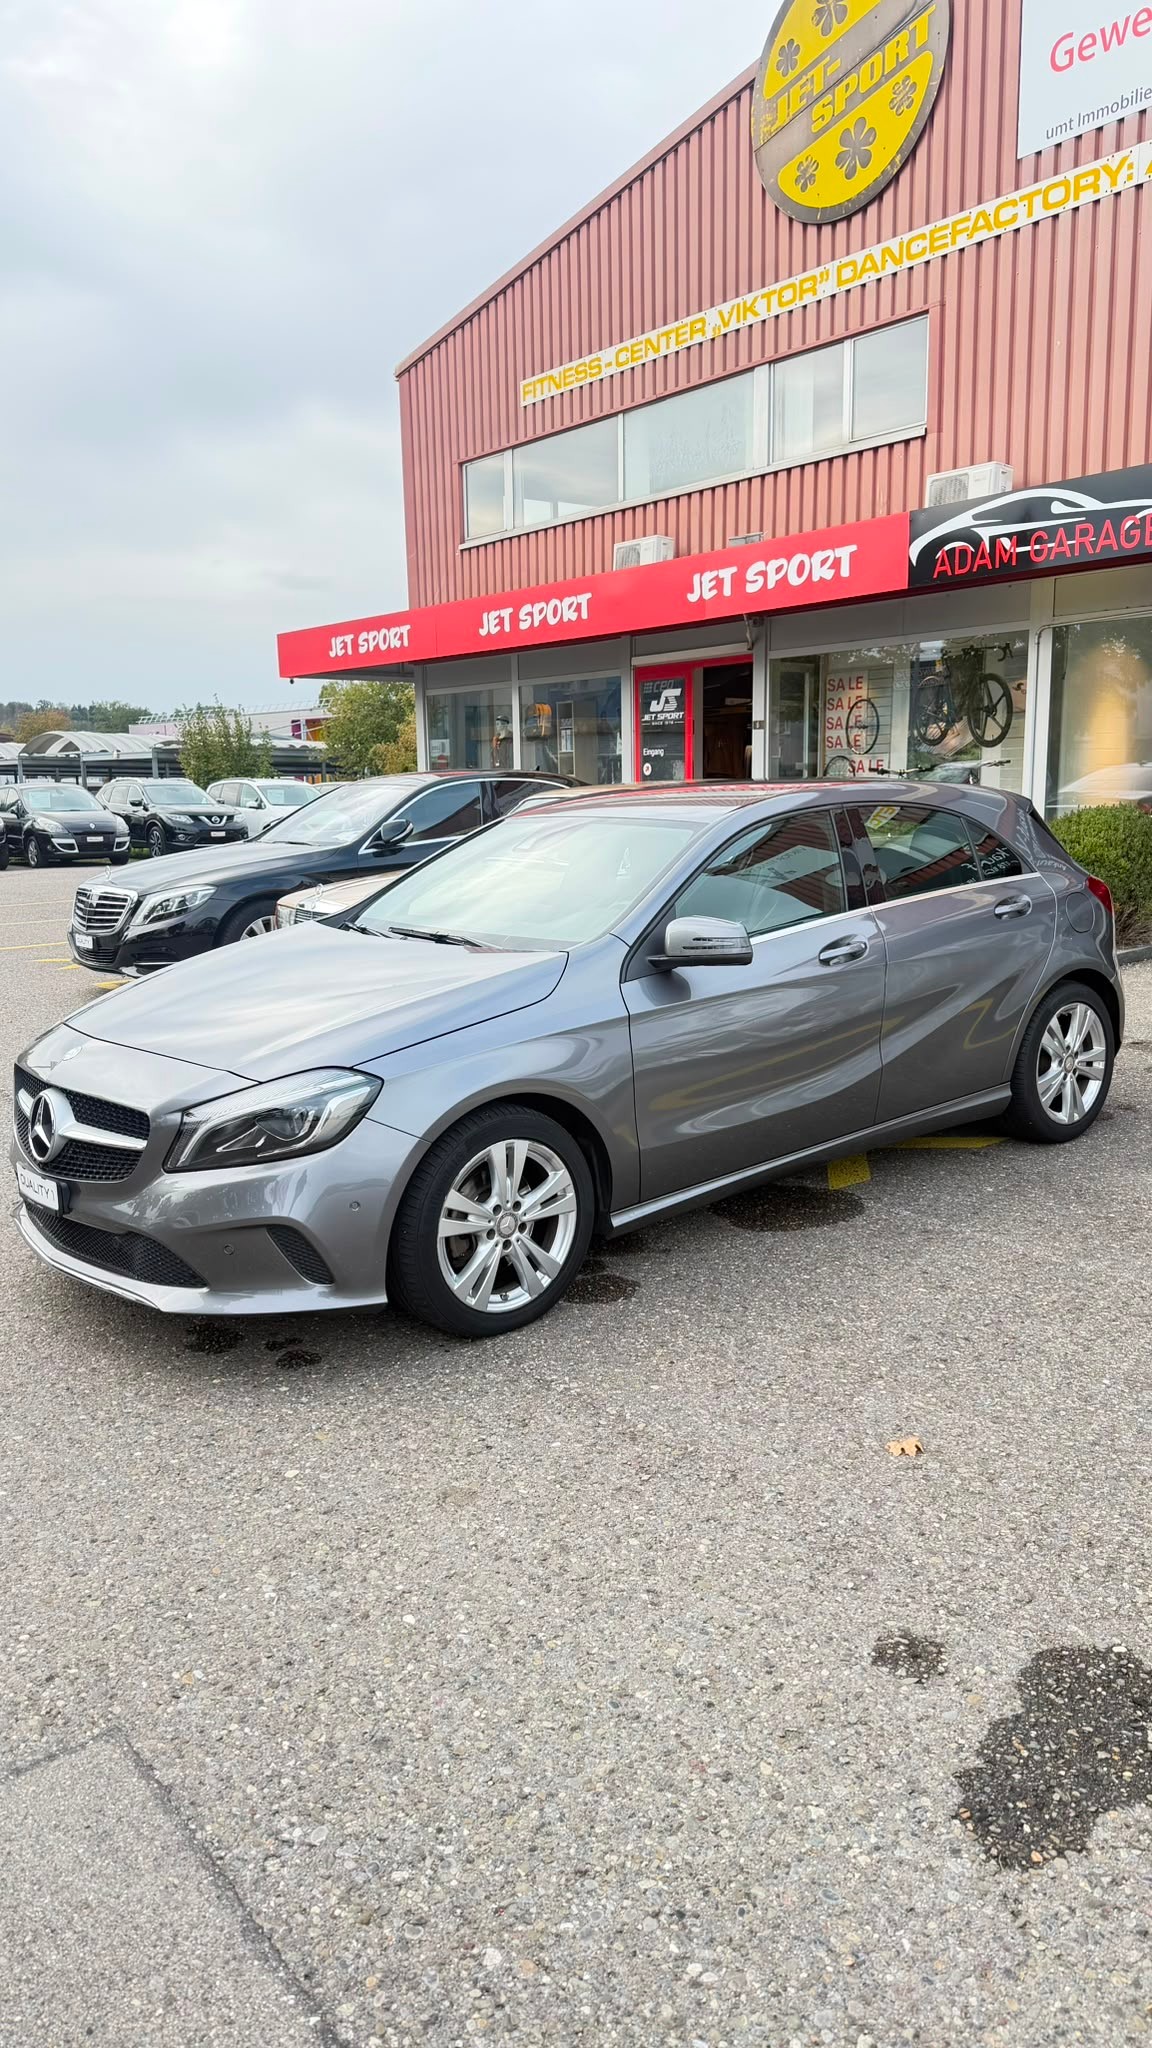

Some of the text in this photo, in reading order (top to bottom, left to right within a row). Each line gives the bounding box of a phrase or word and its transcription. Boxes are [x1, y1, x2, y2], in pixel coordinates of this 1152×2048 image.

[1050, 7, 1152, 73] Gewe
[811, 4, 936, 133] SPORT
[1045, 86, 1152, 140] umt Immobilie
[836, 155, 1134, 288] DANCEFACTORY:
[686, 544, 858, 603] JET SPORT
[933, 535, 1018, 579] ADAM
[478, 592, 592, 637] JET SPORT
[328, 624, 411, 658] JET SPORT
[827, 676, 864, 692] SALE
[641, 712, 684, 721] JET SPORT
[643, 748, 665, 757] Eingang
[826, 734, 862, 749] SAE
